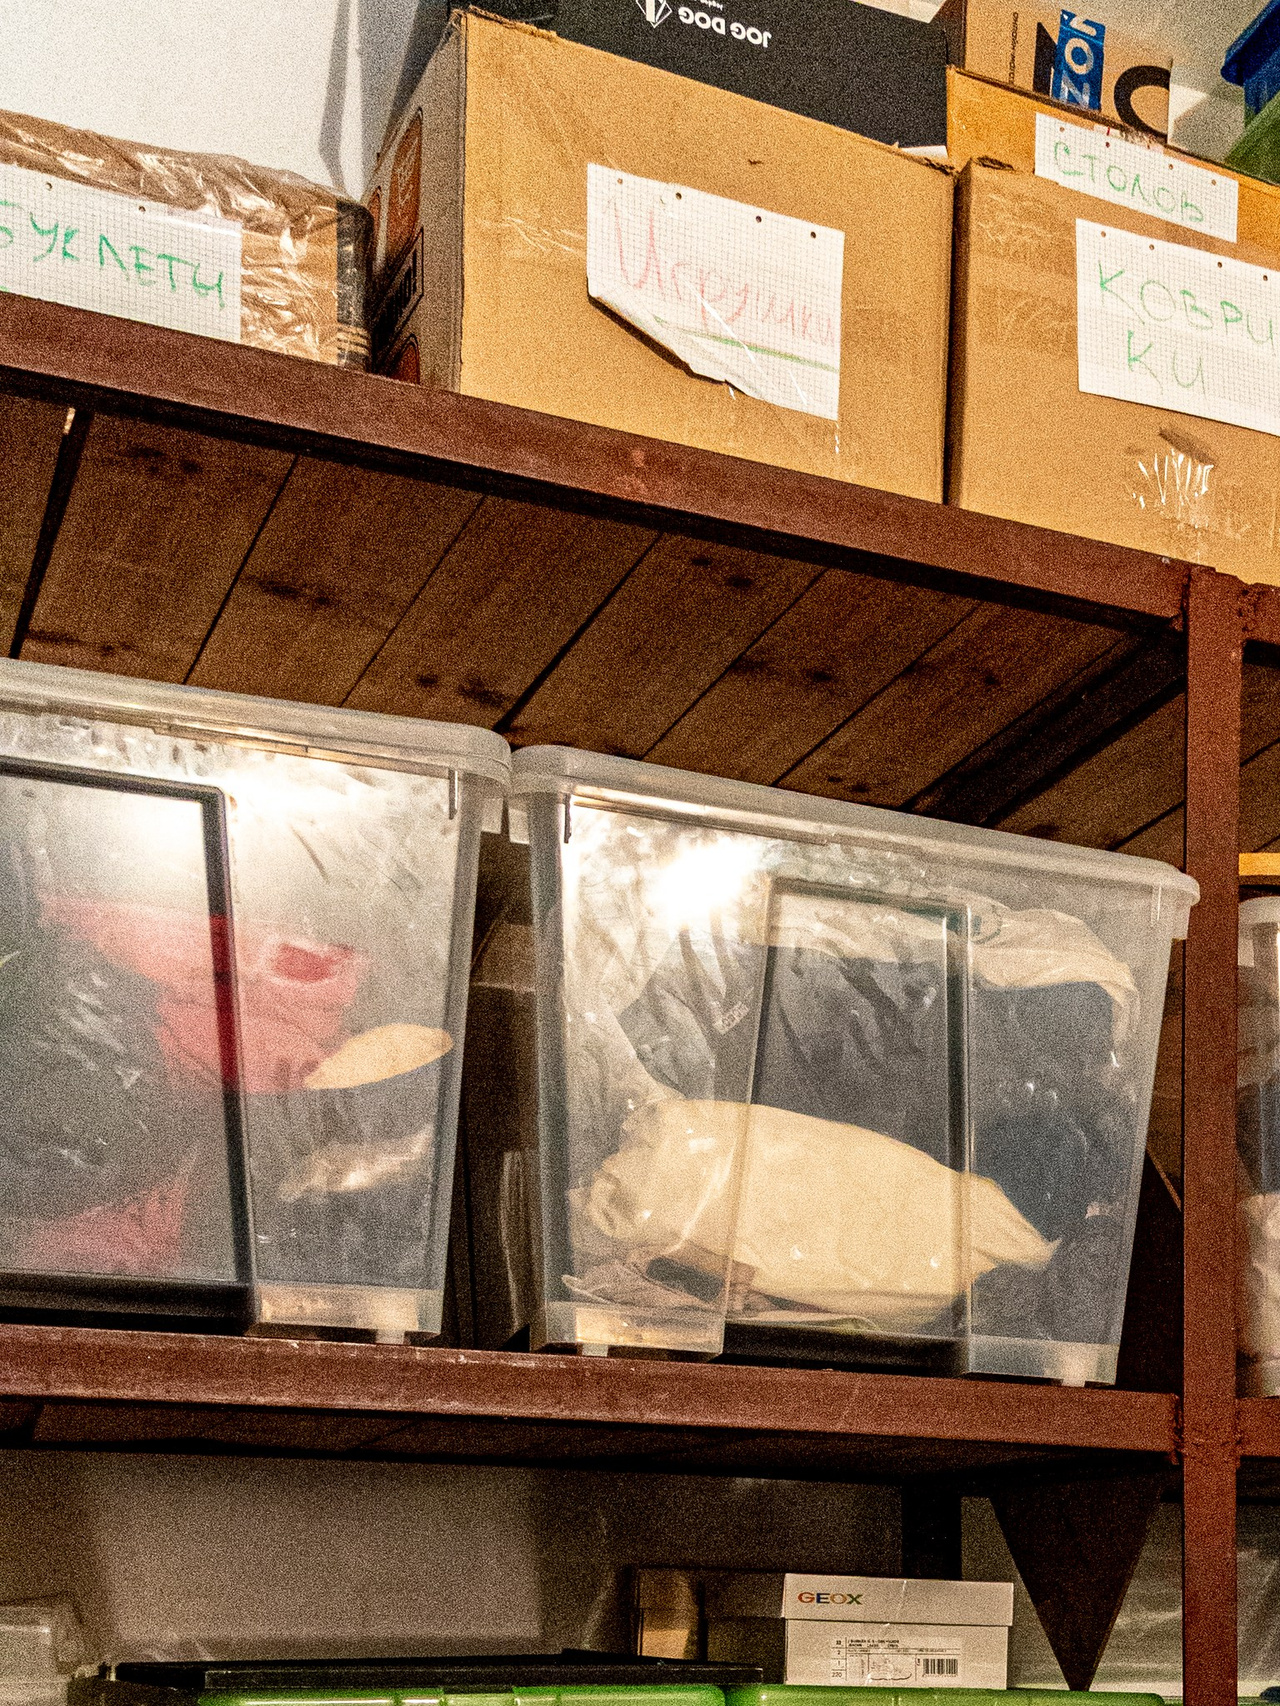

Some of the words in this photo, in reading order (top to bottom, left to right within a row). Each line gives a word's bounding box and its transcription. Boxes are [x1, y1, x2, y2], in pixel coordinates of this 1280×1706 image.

[678, 6, 726, 36] DOG
[730, 22, 772, 48] JOG
[1128, 330, 1207, 398] КИ
[798, 1591, 863, 1606] GEOX
